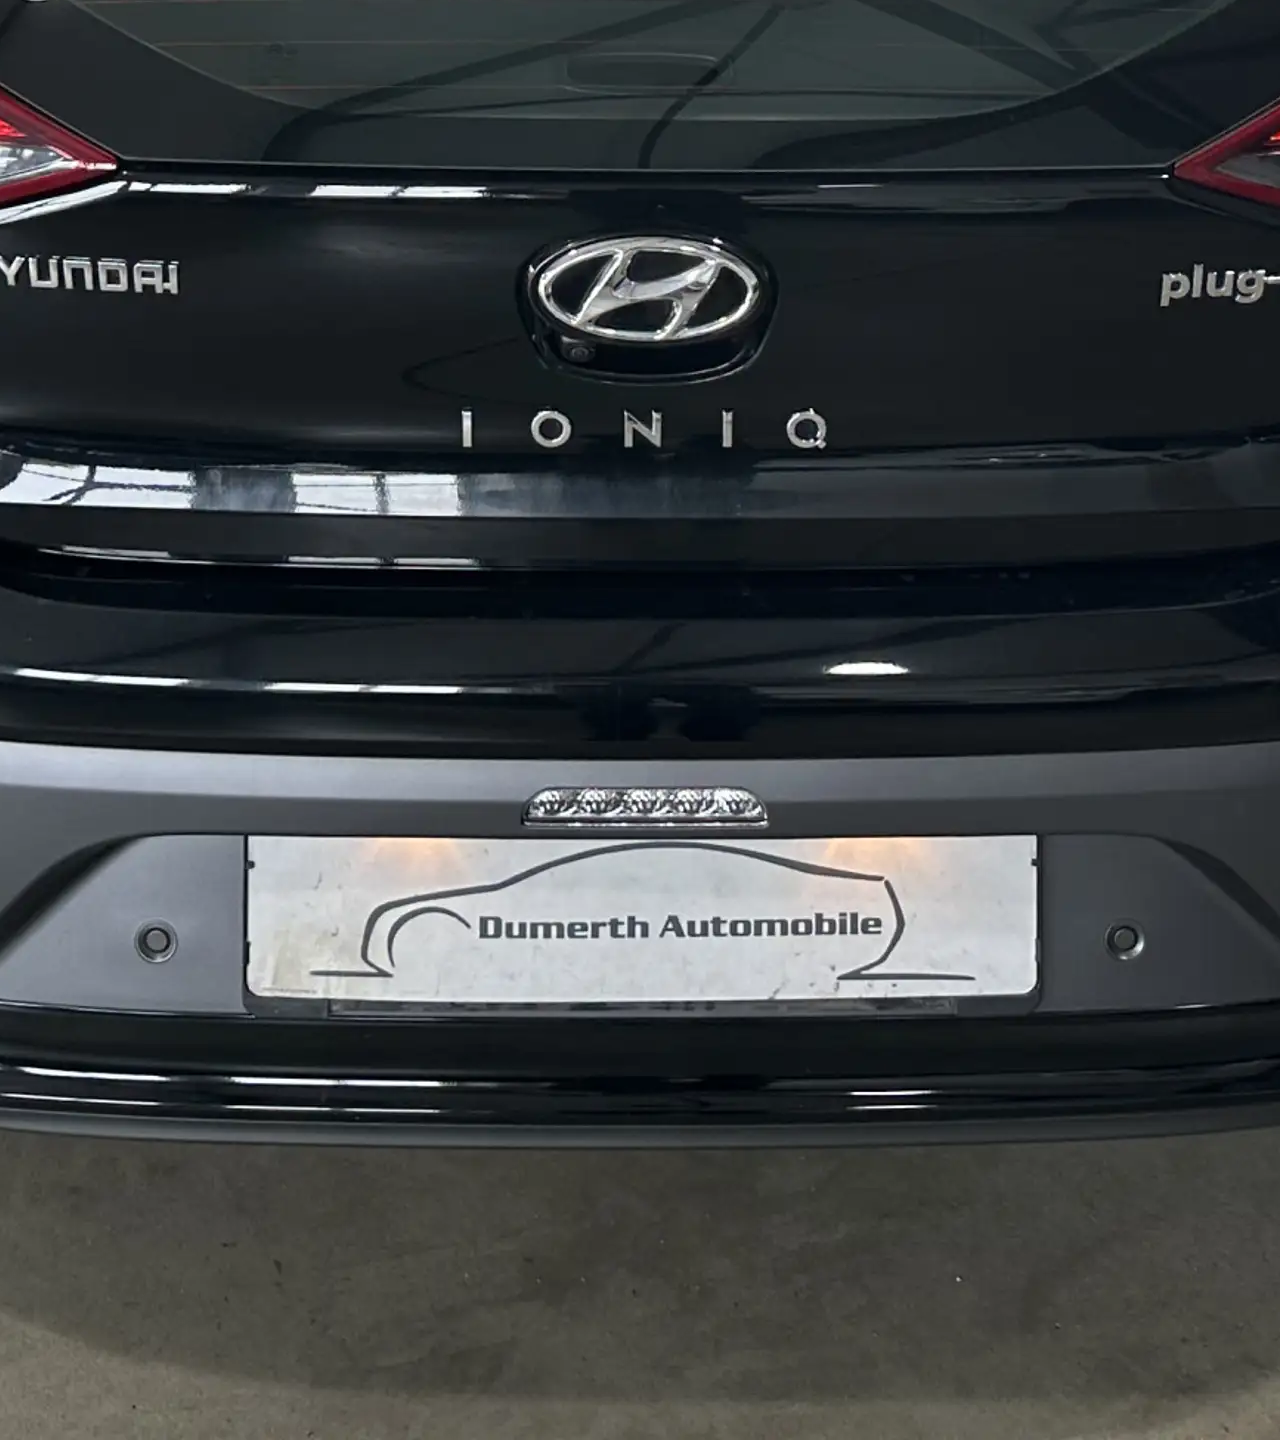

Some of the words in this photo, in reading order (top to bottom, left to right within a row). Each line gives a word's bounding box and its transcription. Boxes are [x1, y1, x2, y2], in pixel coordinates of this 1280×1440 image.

[460, 407, 828, 449] IONIQ
[479, 916, 649, 939] Dumerth
[659, 912, 882, 938] Automobile
